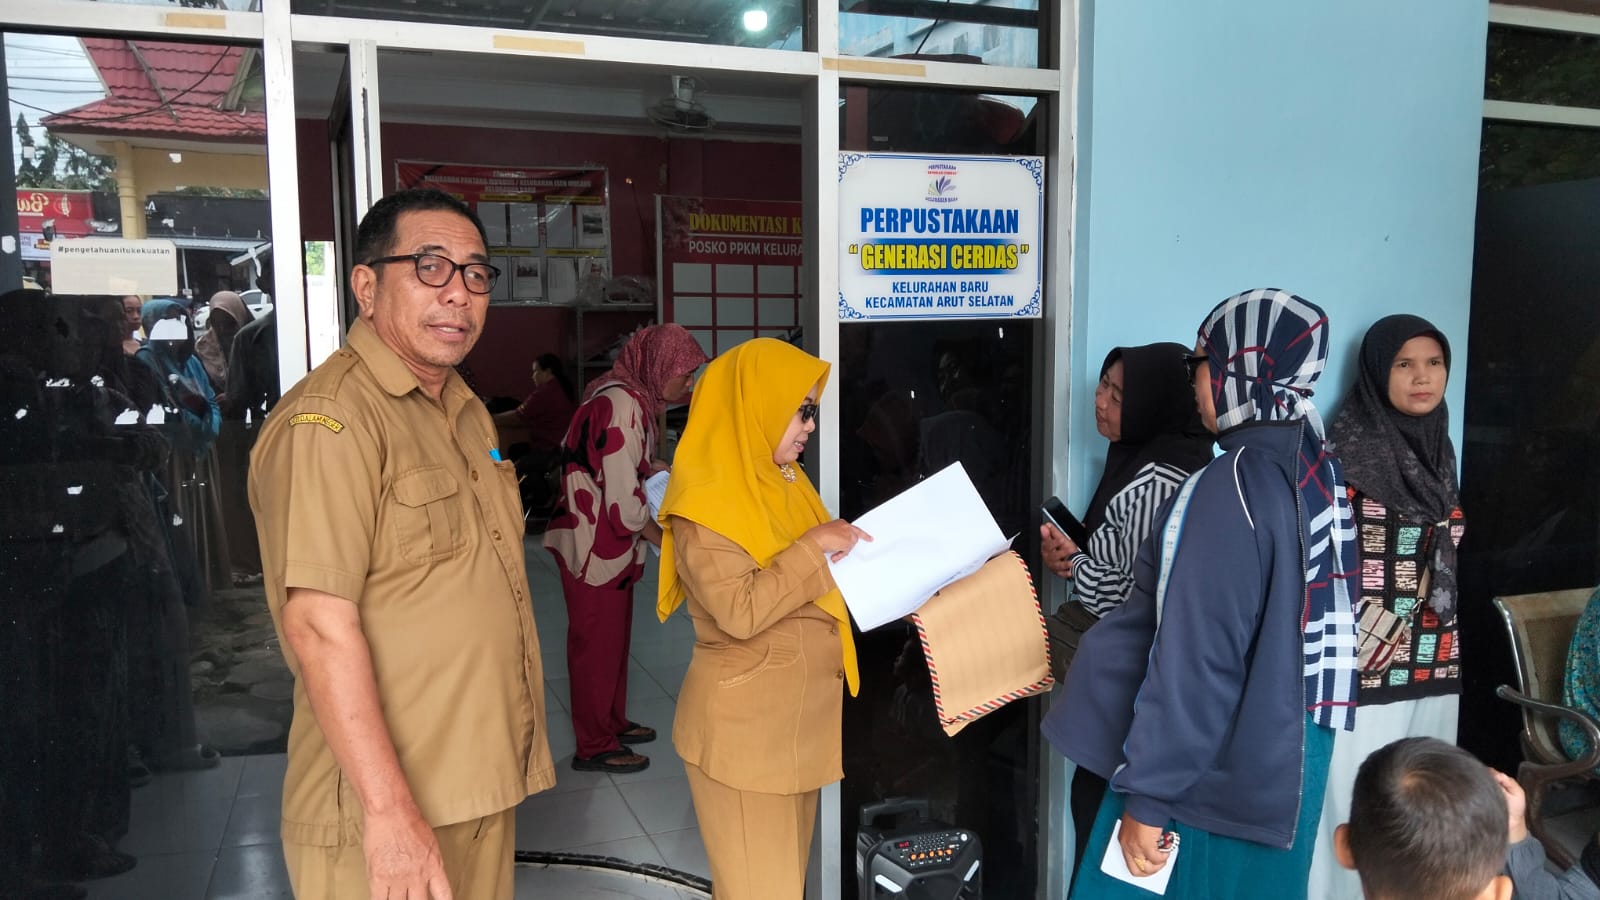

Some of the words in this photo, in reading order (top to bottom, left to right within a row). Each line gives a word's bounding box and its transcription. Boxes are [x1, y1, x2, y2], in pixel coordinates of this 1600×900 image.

[689, 213, 788, 234] DOKUMENTASI
[860, 207, 1019, 234] PERPUSTAKAAN
[58, 246, 170, 255] #pengetahuanitukekuatan
[689, 241, 727, 254] POSKO
[730, 242, 760, 255] PPKM
[892, 281, 957, 294] KELURAHAN
[960, 281, 989, 293] BARU
[865, 296, 931, 309] KECAMATAN
[936, 296, 965, 308] ARUT
[968, 295, 1014, 307] SELATAN
